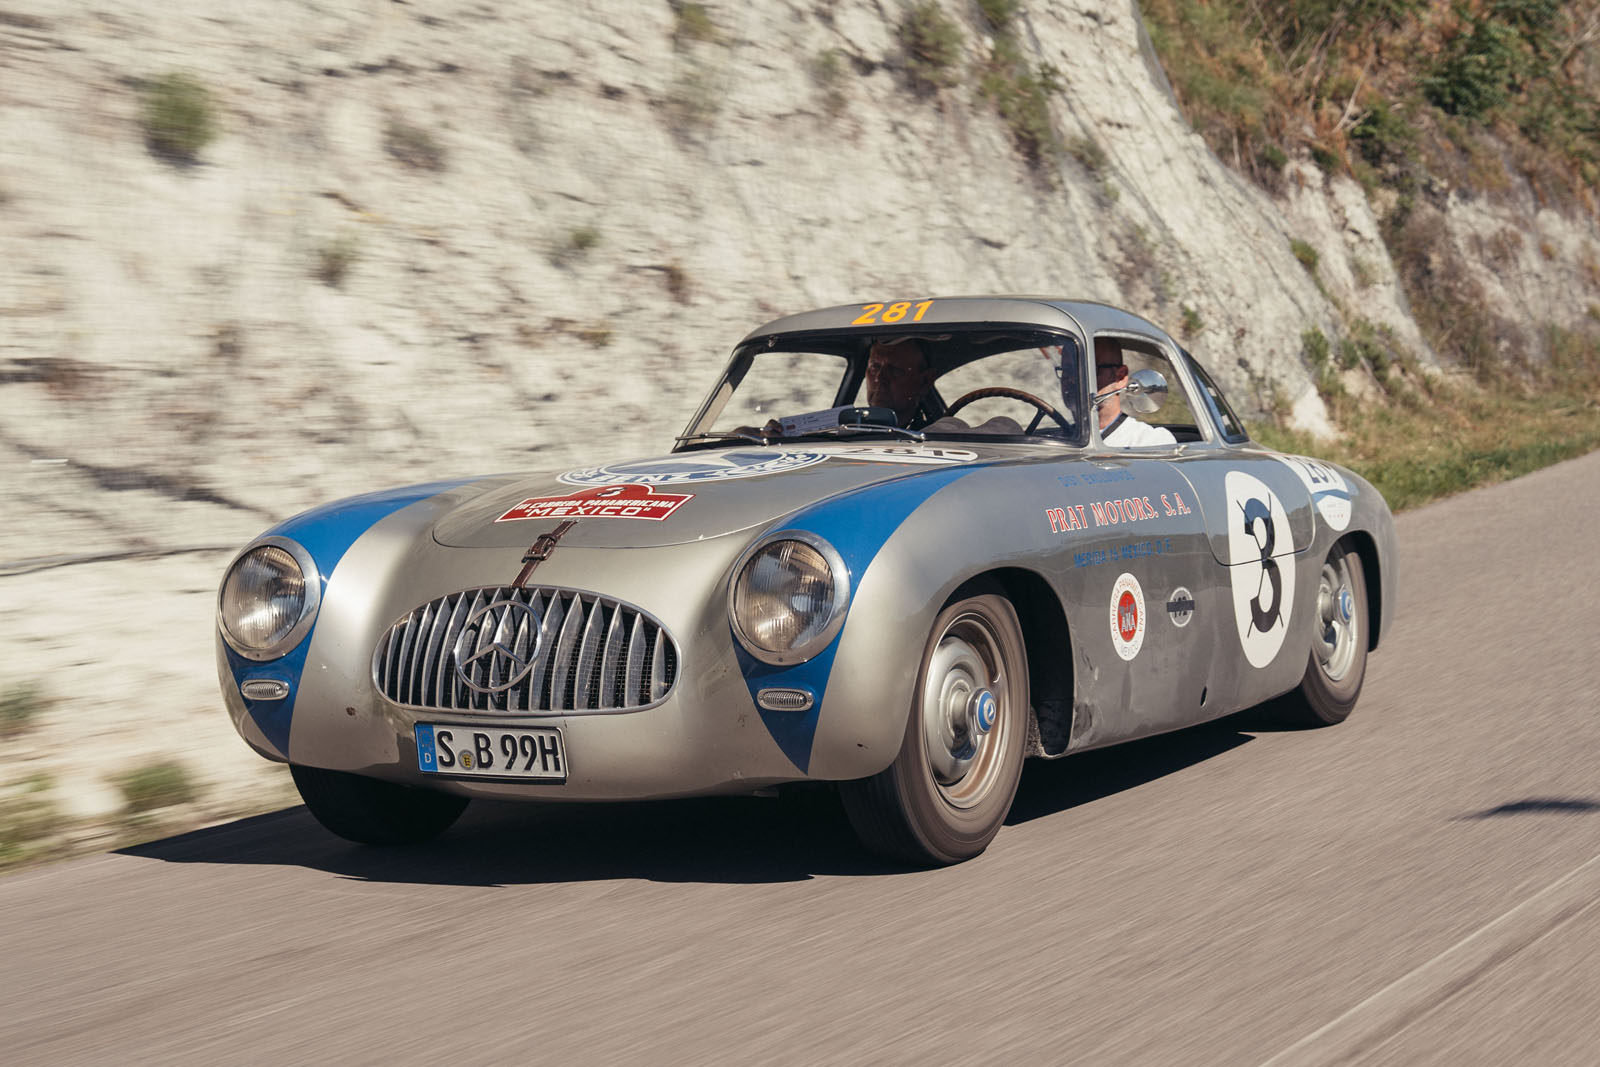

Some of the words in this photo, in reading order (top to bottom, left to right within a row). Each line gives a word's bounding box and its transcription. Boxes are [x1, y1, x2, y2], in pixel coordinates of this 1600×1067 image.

[851, 300, 935, 325] 281
[582, 499, 676, 508] PANAMERICANA
[1045, 504, 1088, 534] PRAT
[1238, 494, 1283, 637] 3
[424, 753, 432, 763] D
[437, 731, 456, 767] S
[473, 733, 494, 769] B
